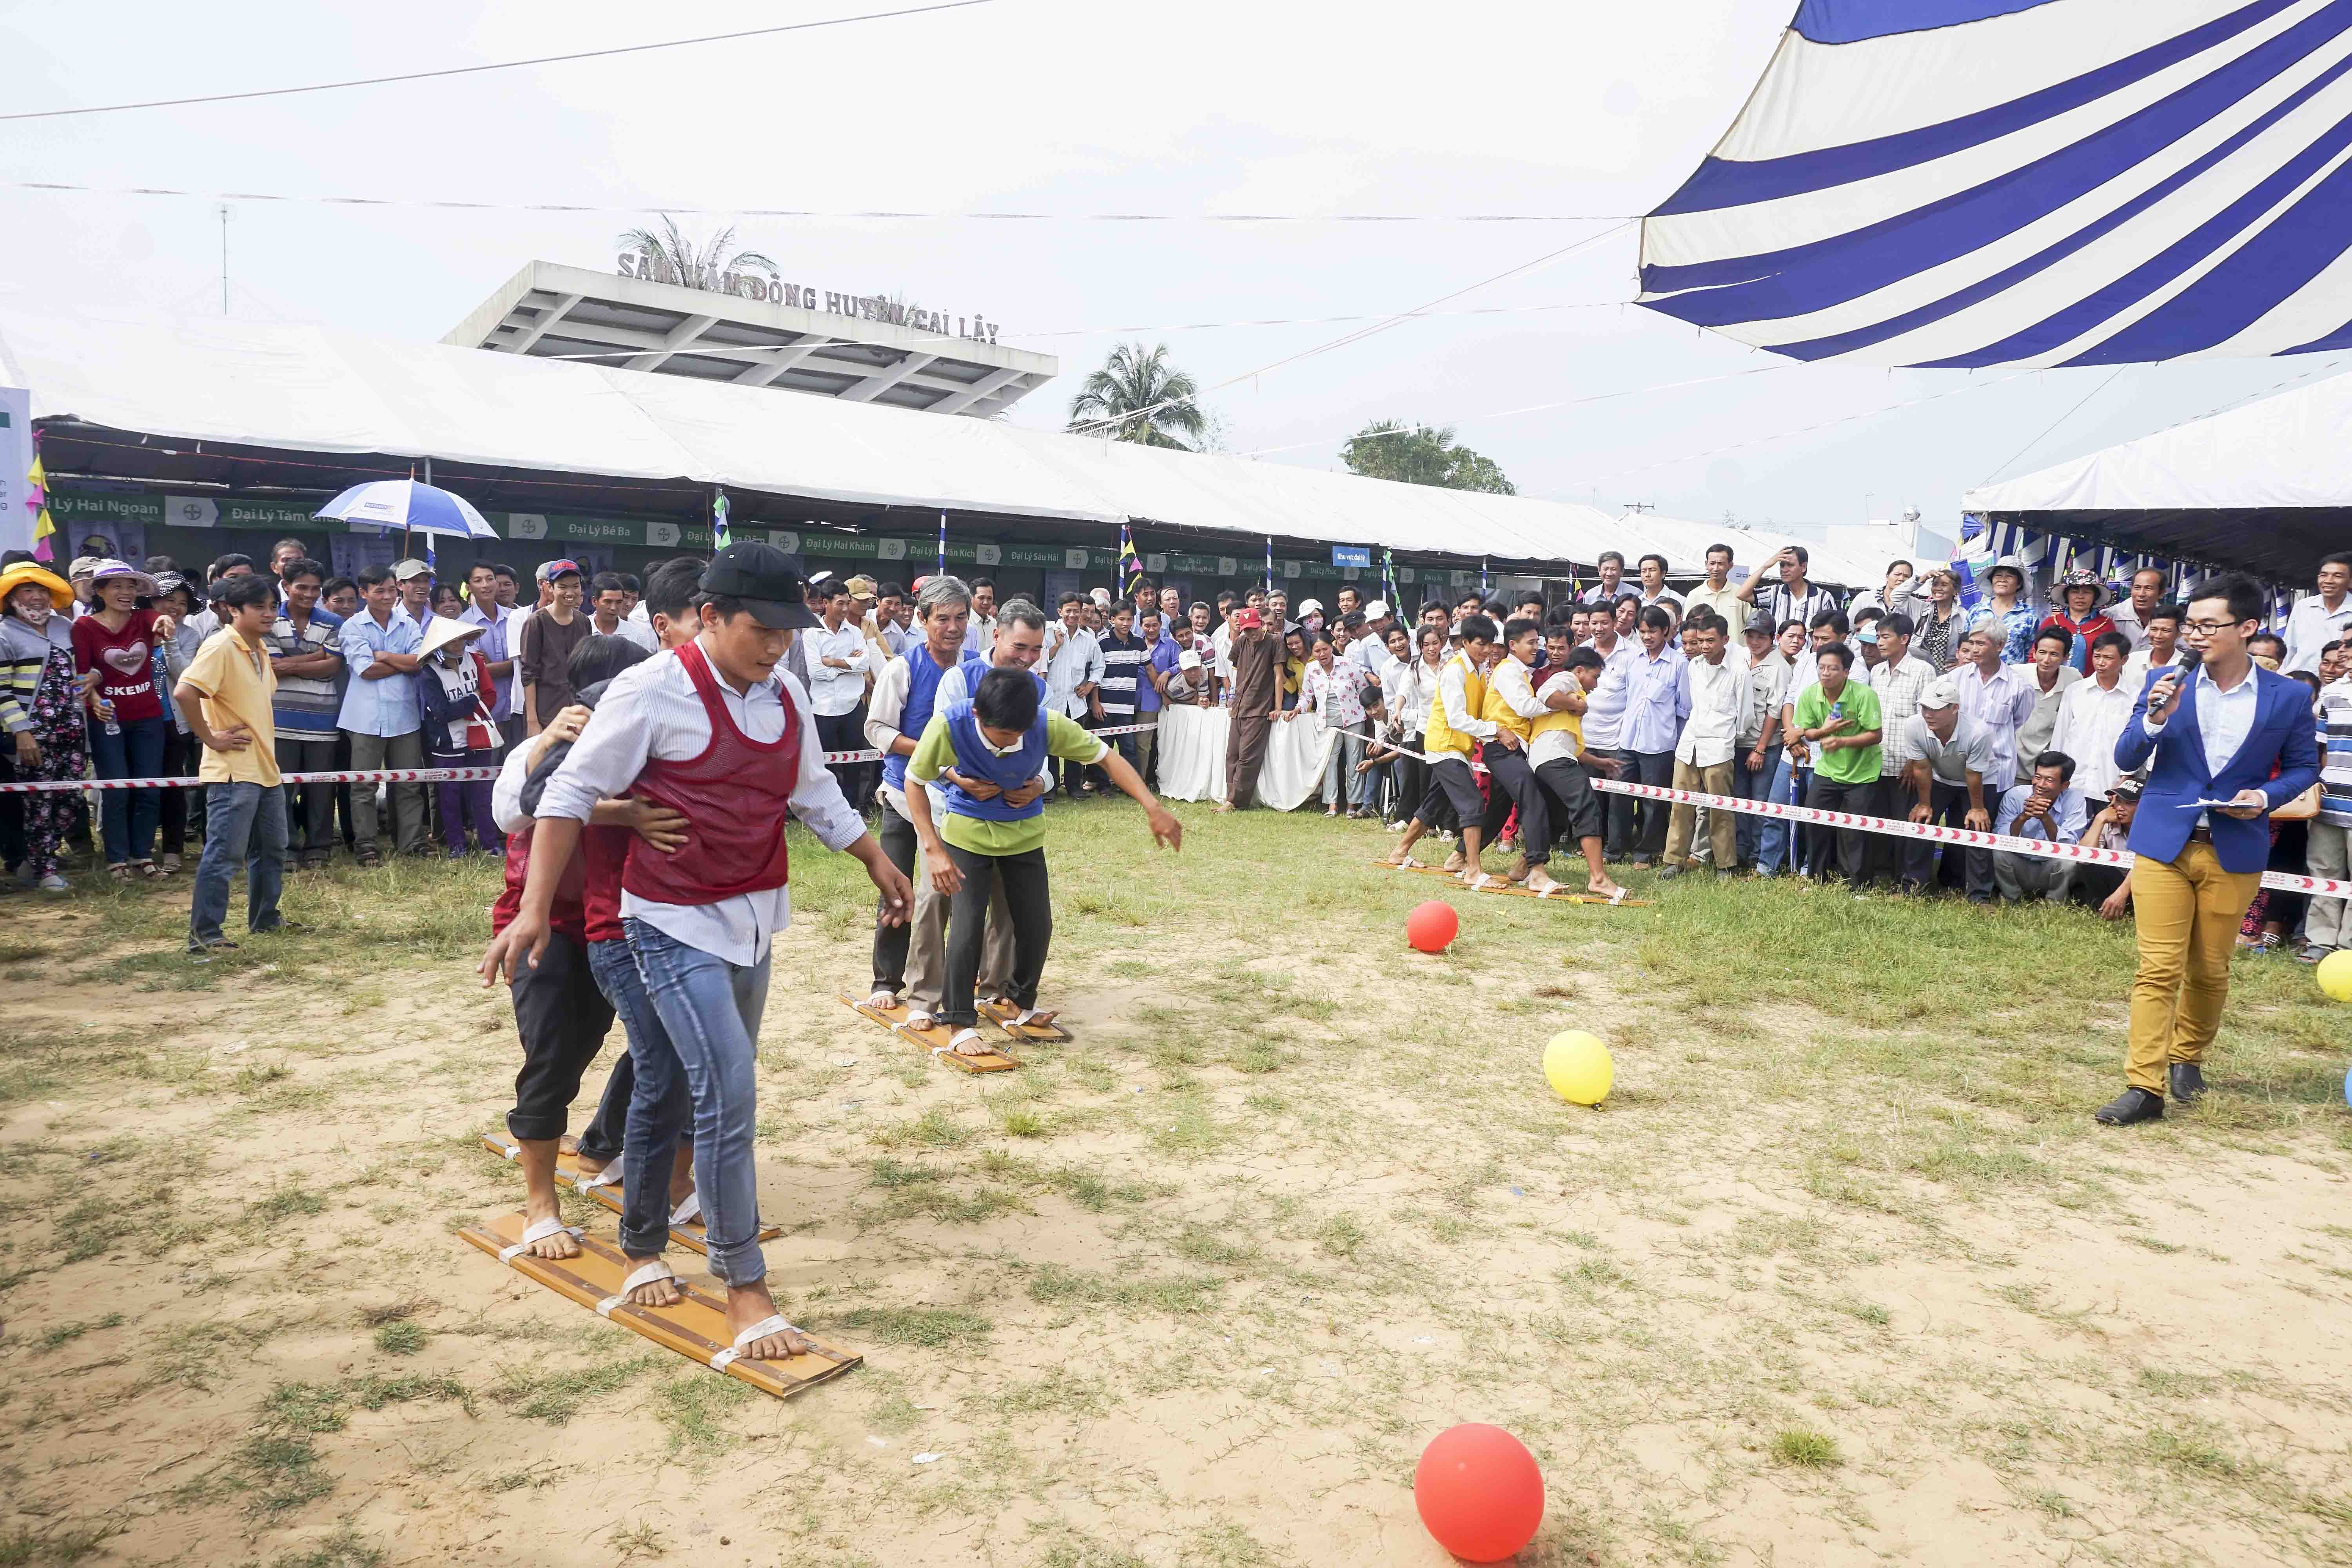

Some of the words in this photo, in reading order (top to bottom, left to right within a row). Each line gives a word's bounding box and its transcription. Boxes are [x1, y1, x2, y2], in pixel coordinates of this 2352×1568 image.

[55, 497, 73, 513] Lý
[77, 499, 103, 511] Hai
[107, 501, 158, 515] Ngoan
[232, 508, 255, 522] Đại
[260, 509, 274, 523] Lý
[277, 508, 305, 522] Tám
[568, 523, 586, 536] Đại
[589, 524, 601, 537] Lý
[603, 525, 615, 535] Bé
[618, 526, 631, 536] Ba
[687, 531, 703, 543] Đại
[806, 539, 821, 552] Đại
[823, 539, 832, 552] Lý
[834, 540, 848, 550] Hai
[849, 541, 875, 552] Khánh
[910, 546, 923, 556] Đại
[925, 546, 933, 557] Lý
[1011, 552, 1023, 561] Đại
[1025, 552, 1032, 562] Lý
[1361, 554, 1365, 563] lý
[104, 681, 151, 695] SKEMP
